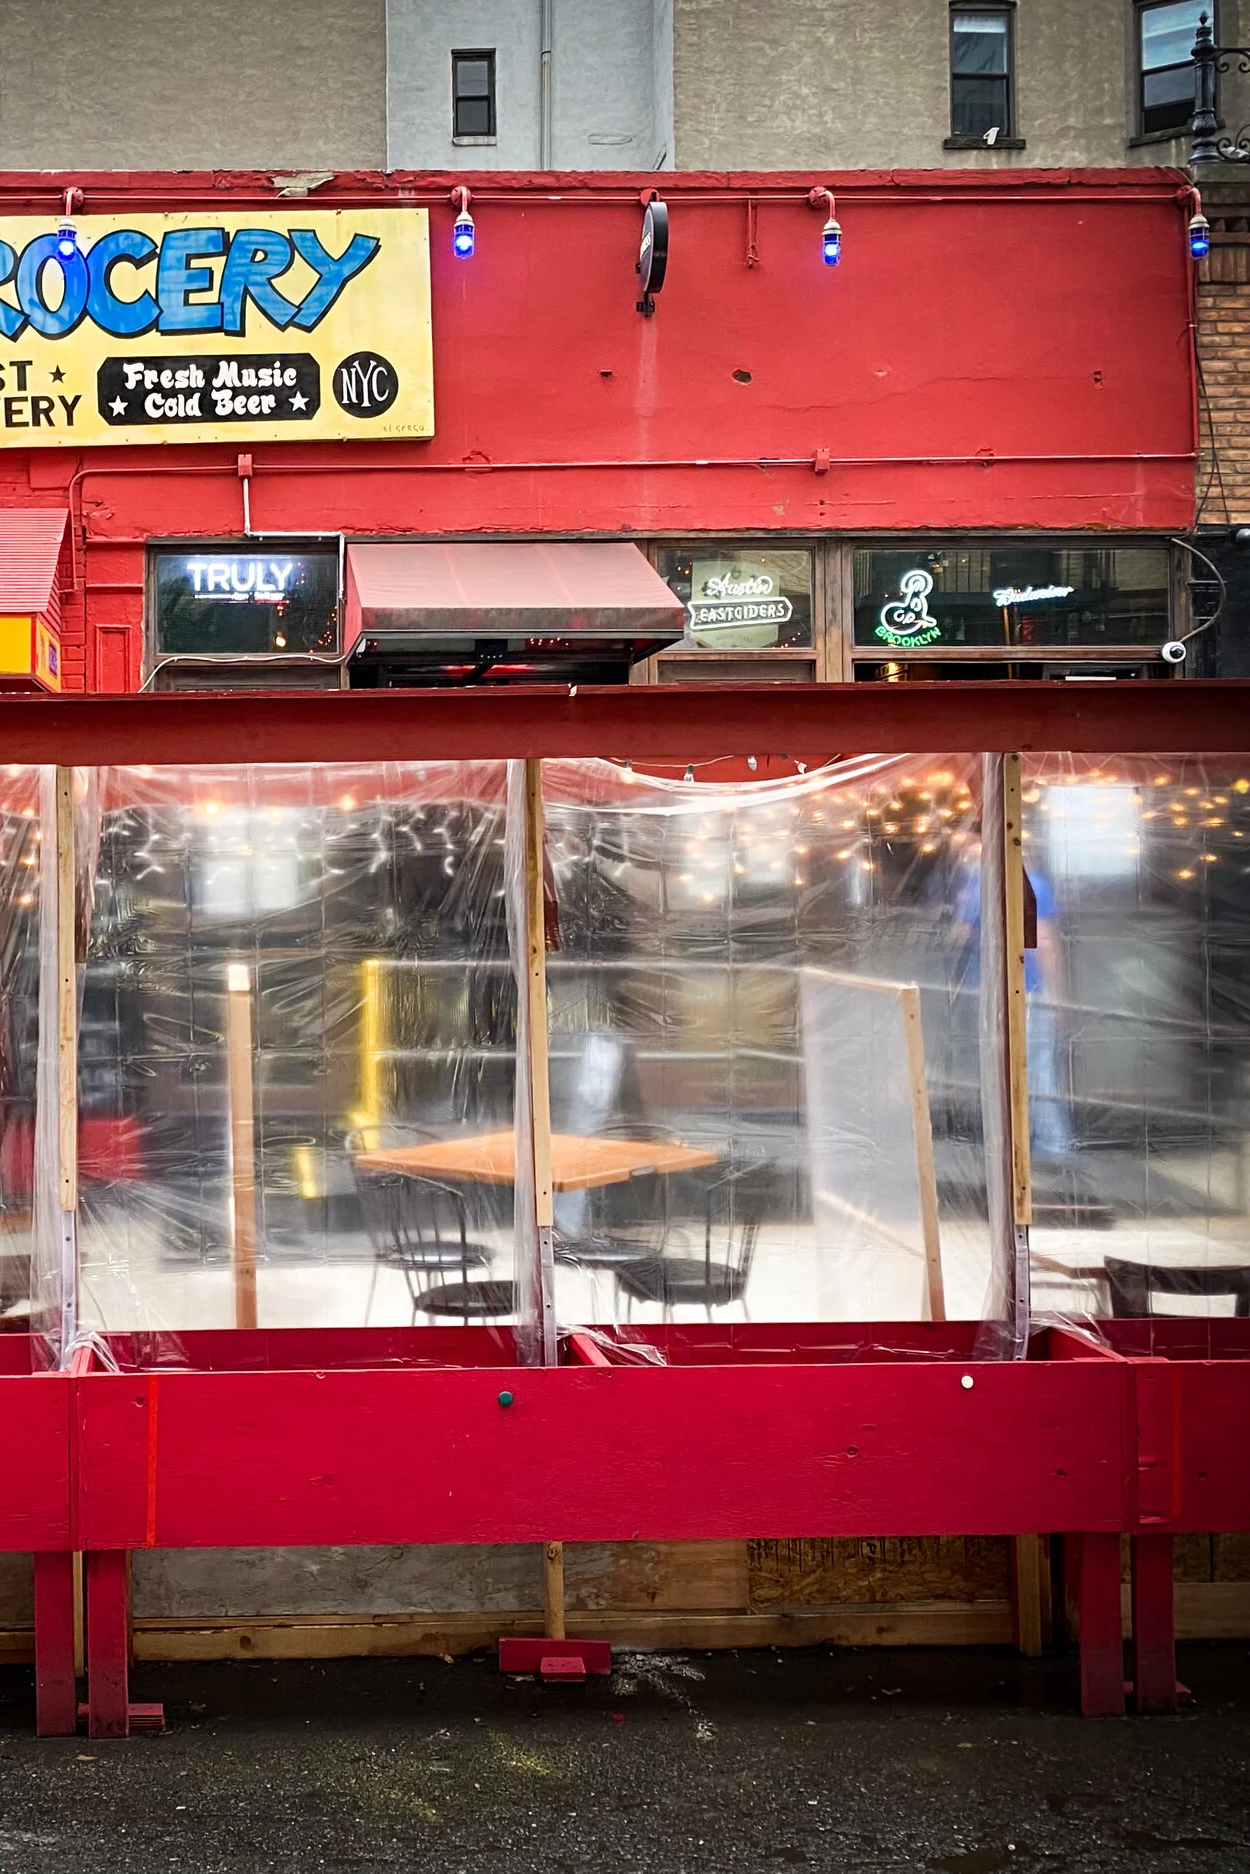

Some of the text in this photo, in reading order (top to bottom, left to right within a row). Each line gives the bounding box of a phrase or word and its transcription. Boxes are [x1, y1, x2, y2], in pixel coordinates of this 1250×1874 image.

[123, 360, 297, 390] Fresh Music
[341, 360, 389, 408] NYC
[144, 388, 276, 418] Cold Beer
[187, 562, 293, 591] TRULY
[875, 626, 942, 649] BROOKLYN
